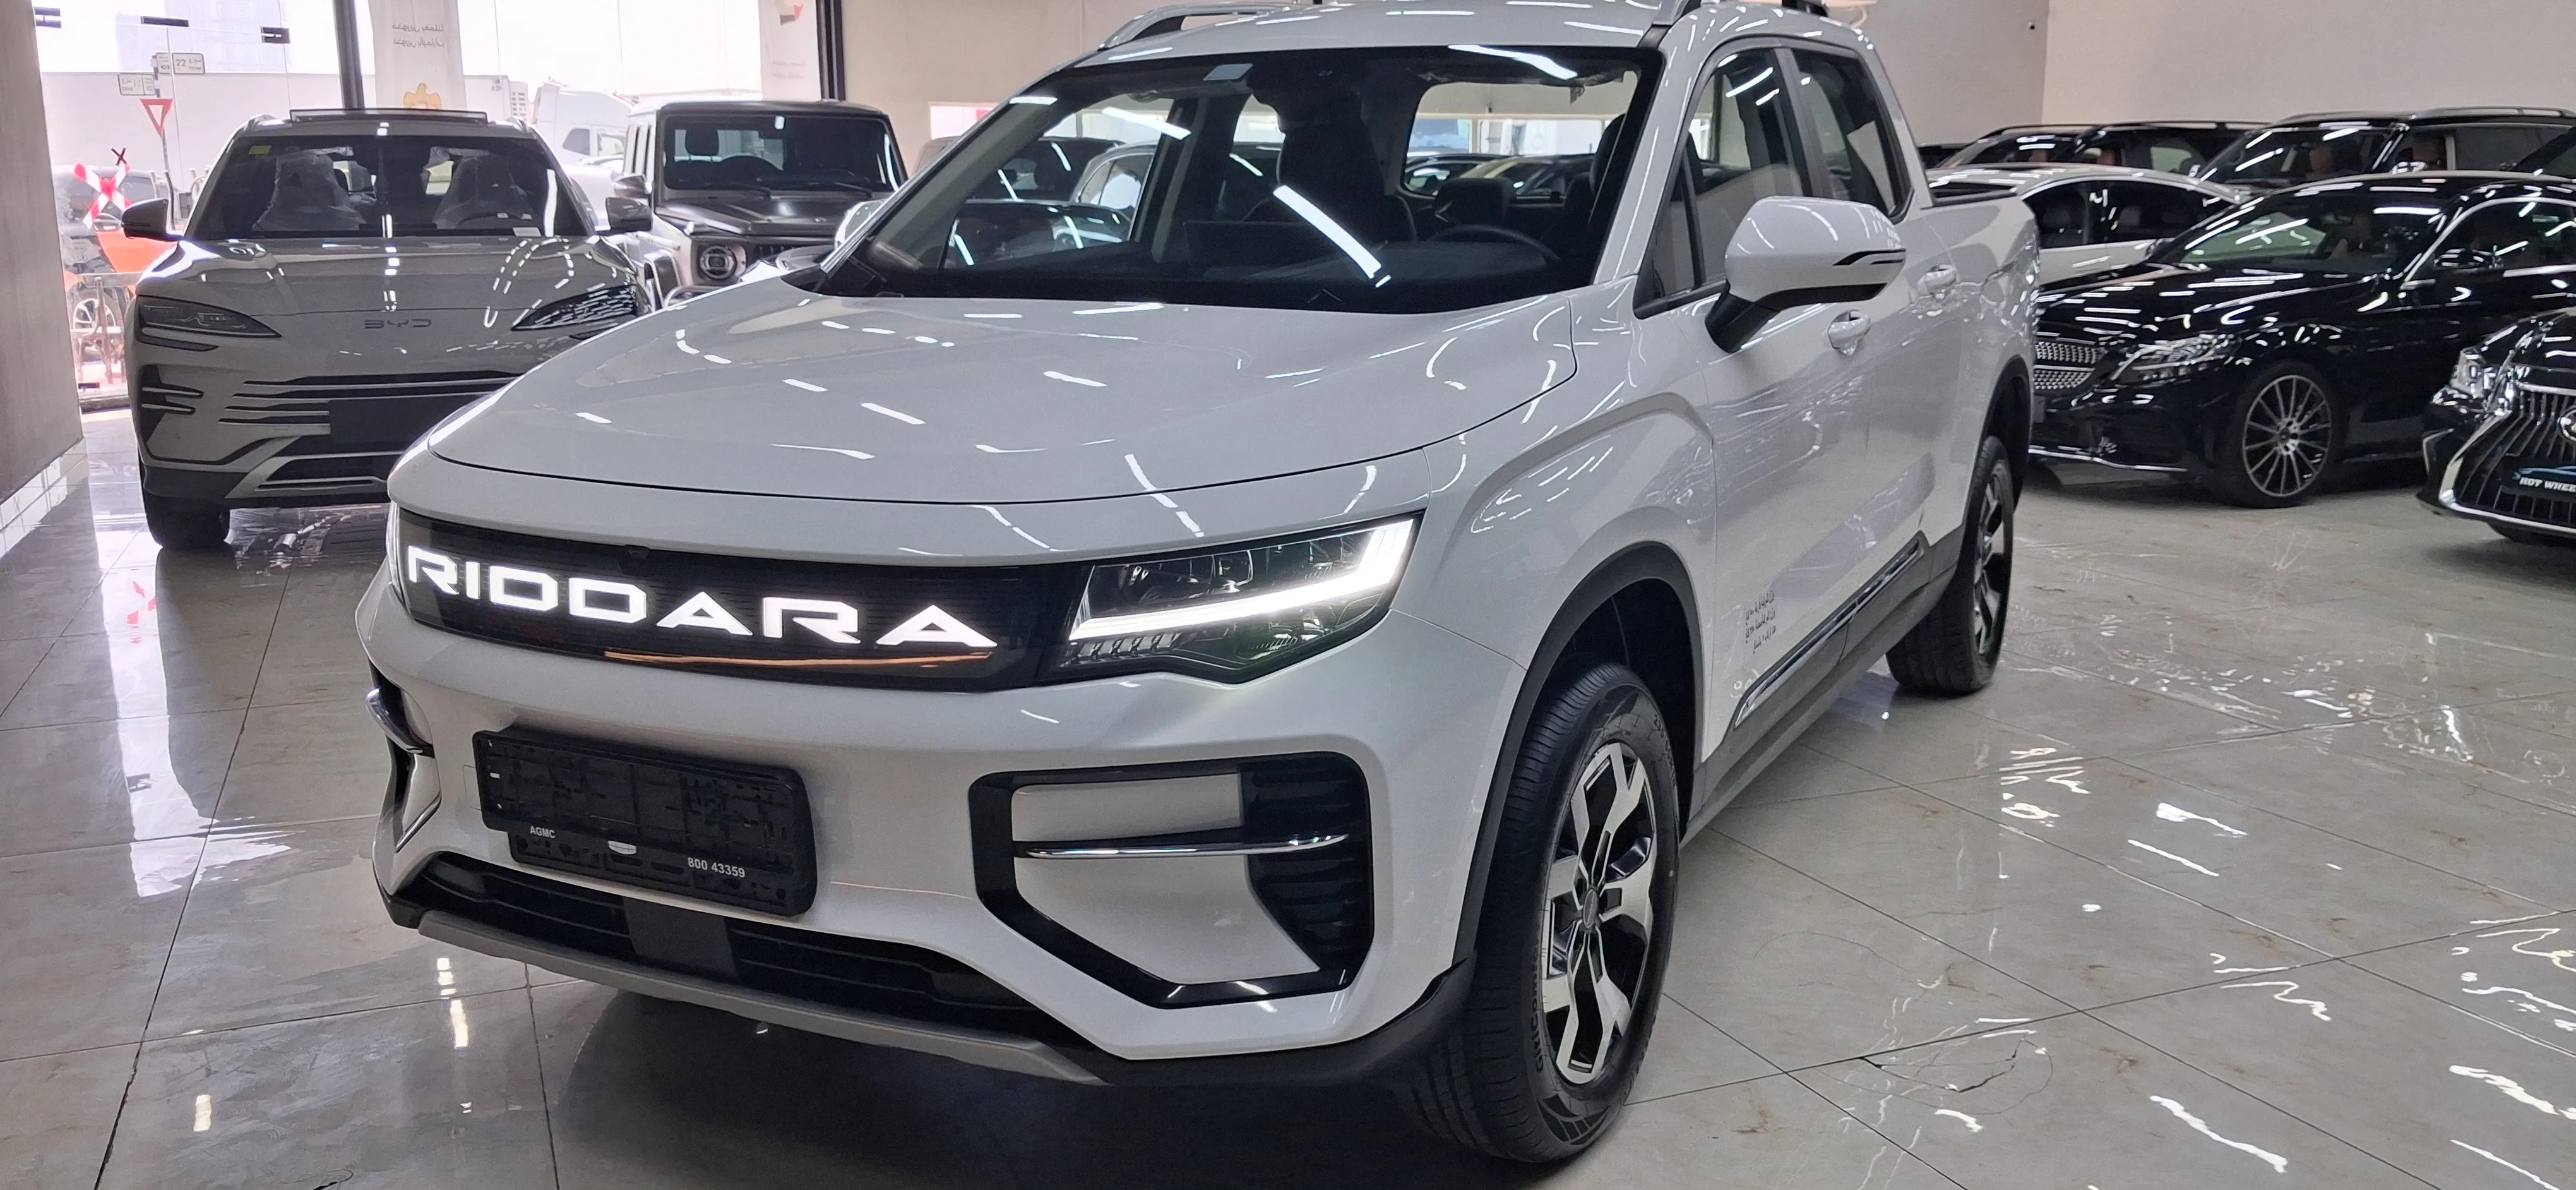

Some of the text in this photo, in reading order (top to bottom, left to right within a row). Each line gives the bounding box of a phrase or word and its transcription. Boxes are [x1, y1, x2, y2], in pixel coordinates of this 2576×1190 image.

[364, 319, 432, 328] BYD
[2519, 477, 2543, 488] HOT
[408, 544, 997, 647] RIDDARA
[530, 826, 556, 839] AGMC
[688, 857, 746, 878] 800 43359
